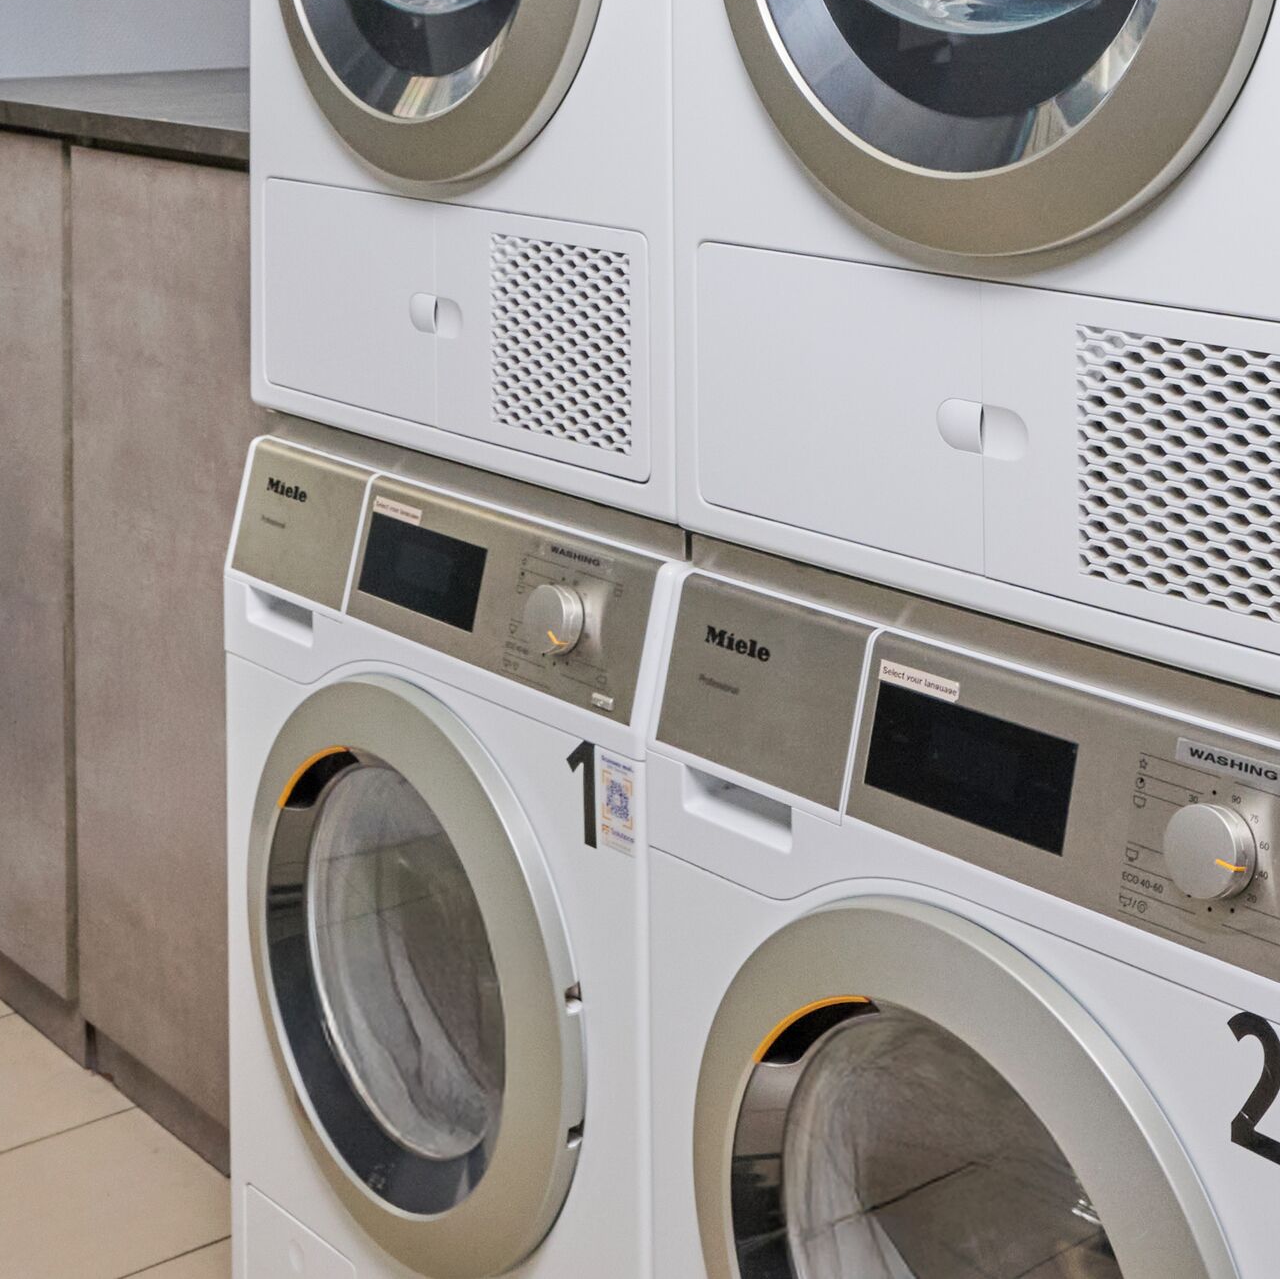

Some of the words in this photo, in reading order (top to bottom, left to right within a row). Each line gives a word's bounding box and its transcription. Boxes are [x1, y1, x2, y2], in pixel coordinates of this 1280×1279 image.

[267, 477, 307, 503] Miele
[551, 545, 600, 567] WASHING
[704, 625, 770, 662] Miele
[882, 666, 905, 680] Select
[906, 674, 922, 685] your
[1189, 746, 1278, 781] WASHING
[566, 740, 597, 849] 1
[1259, 841, 1269, 851] 60
[1122, 871, 1140, 885] ECO
[1140, 879, 1164, 894] 40-60
